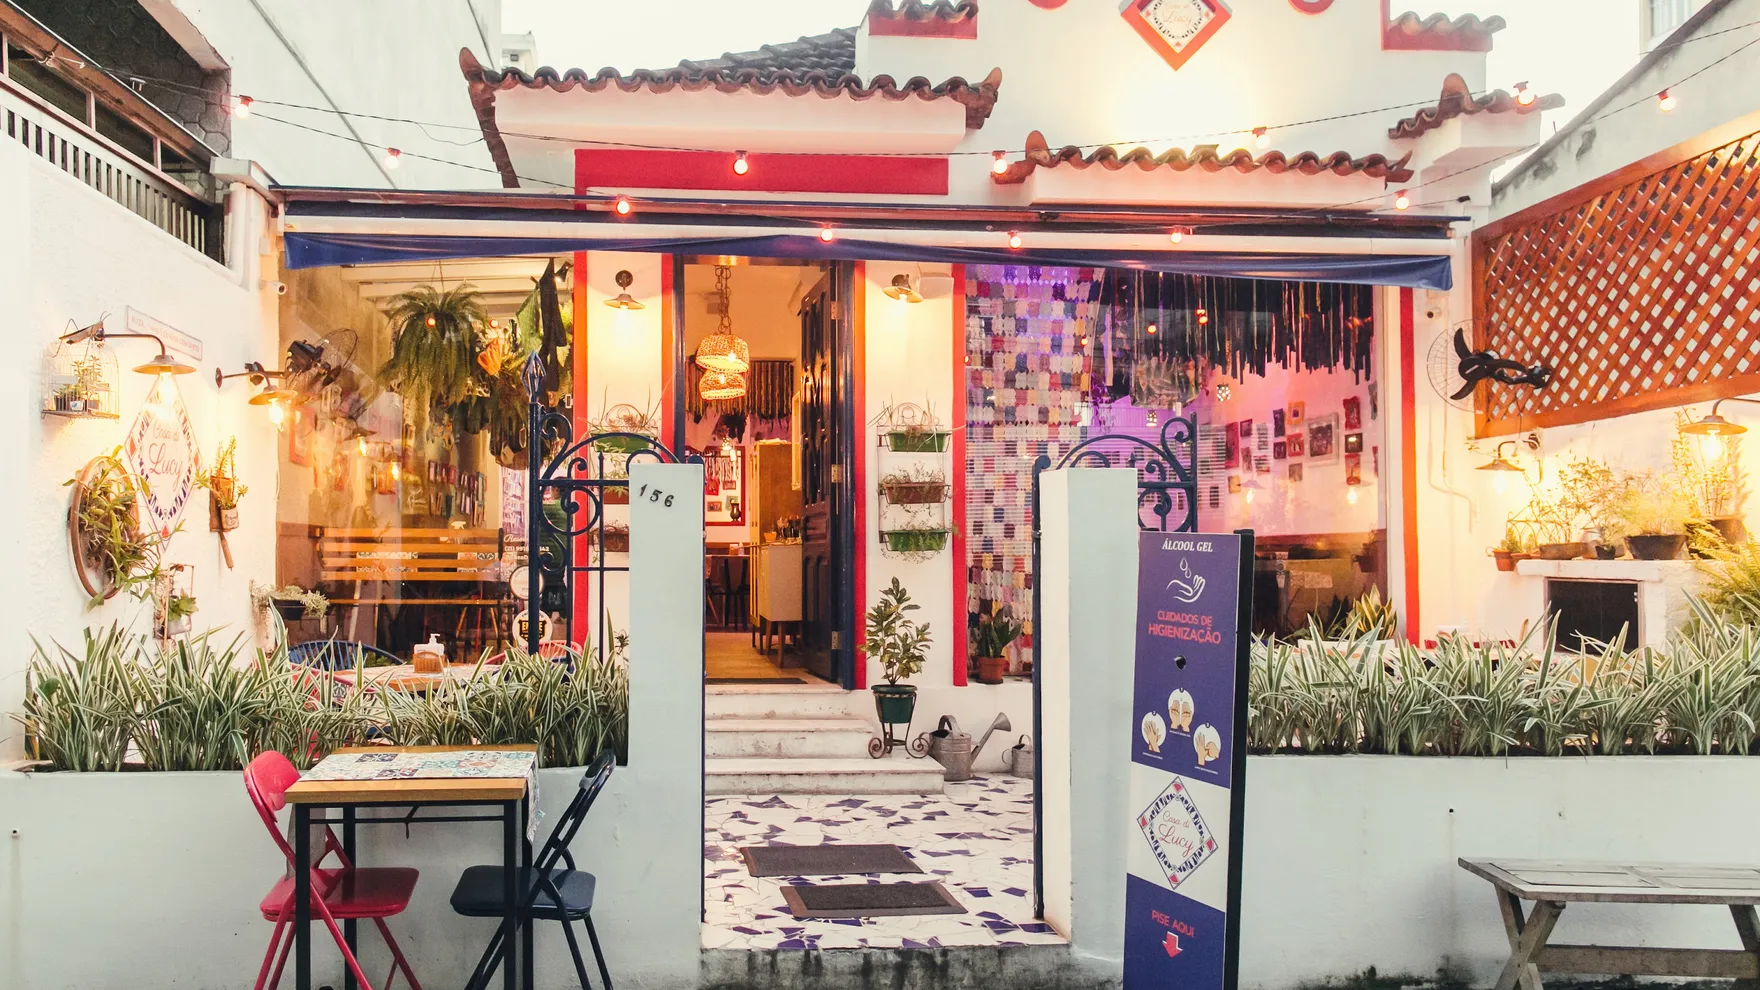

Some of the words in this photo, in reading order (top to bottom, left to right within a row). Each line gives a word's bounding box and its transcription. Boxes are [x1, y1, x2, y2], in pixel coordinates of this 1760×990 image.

[149, 443, 182, 491] Lucy
[640, 484, 674, 507] 156
[1162, 538, 1194, 551] ÁLCOOL
[1197, 541, 1213, 552] GEL
[1157, 610, 1198, 625] CUIDADOS
[1201, 616, 1212, 627] DE
[1148, 623, 1221, 644] HIGIENIZAÇÃO
[1163, 811, 1181, 825] Casa
[1183, 820, 1190, 828] di
[1158, 824, 1194, 858] Lucy
[1151, 910, 1169, 927] PISE
[1172, 918, 1195, 937] AQUI
